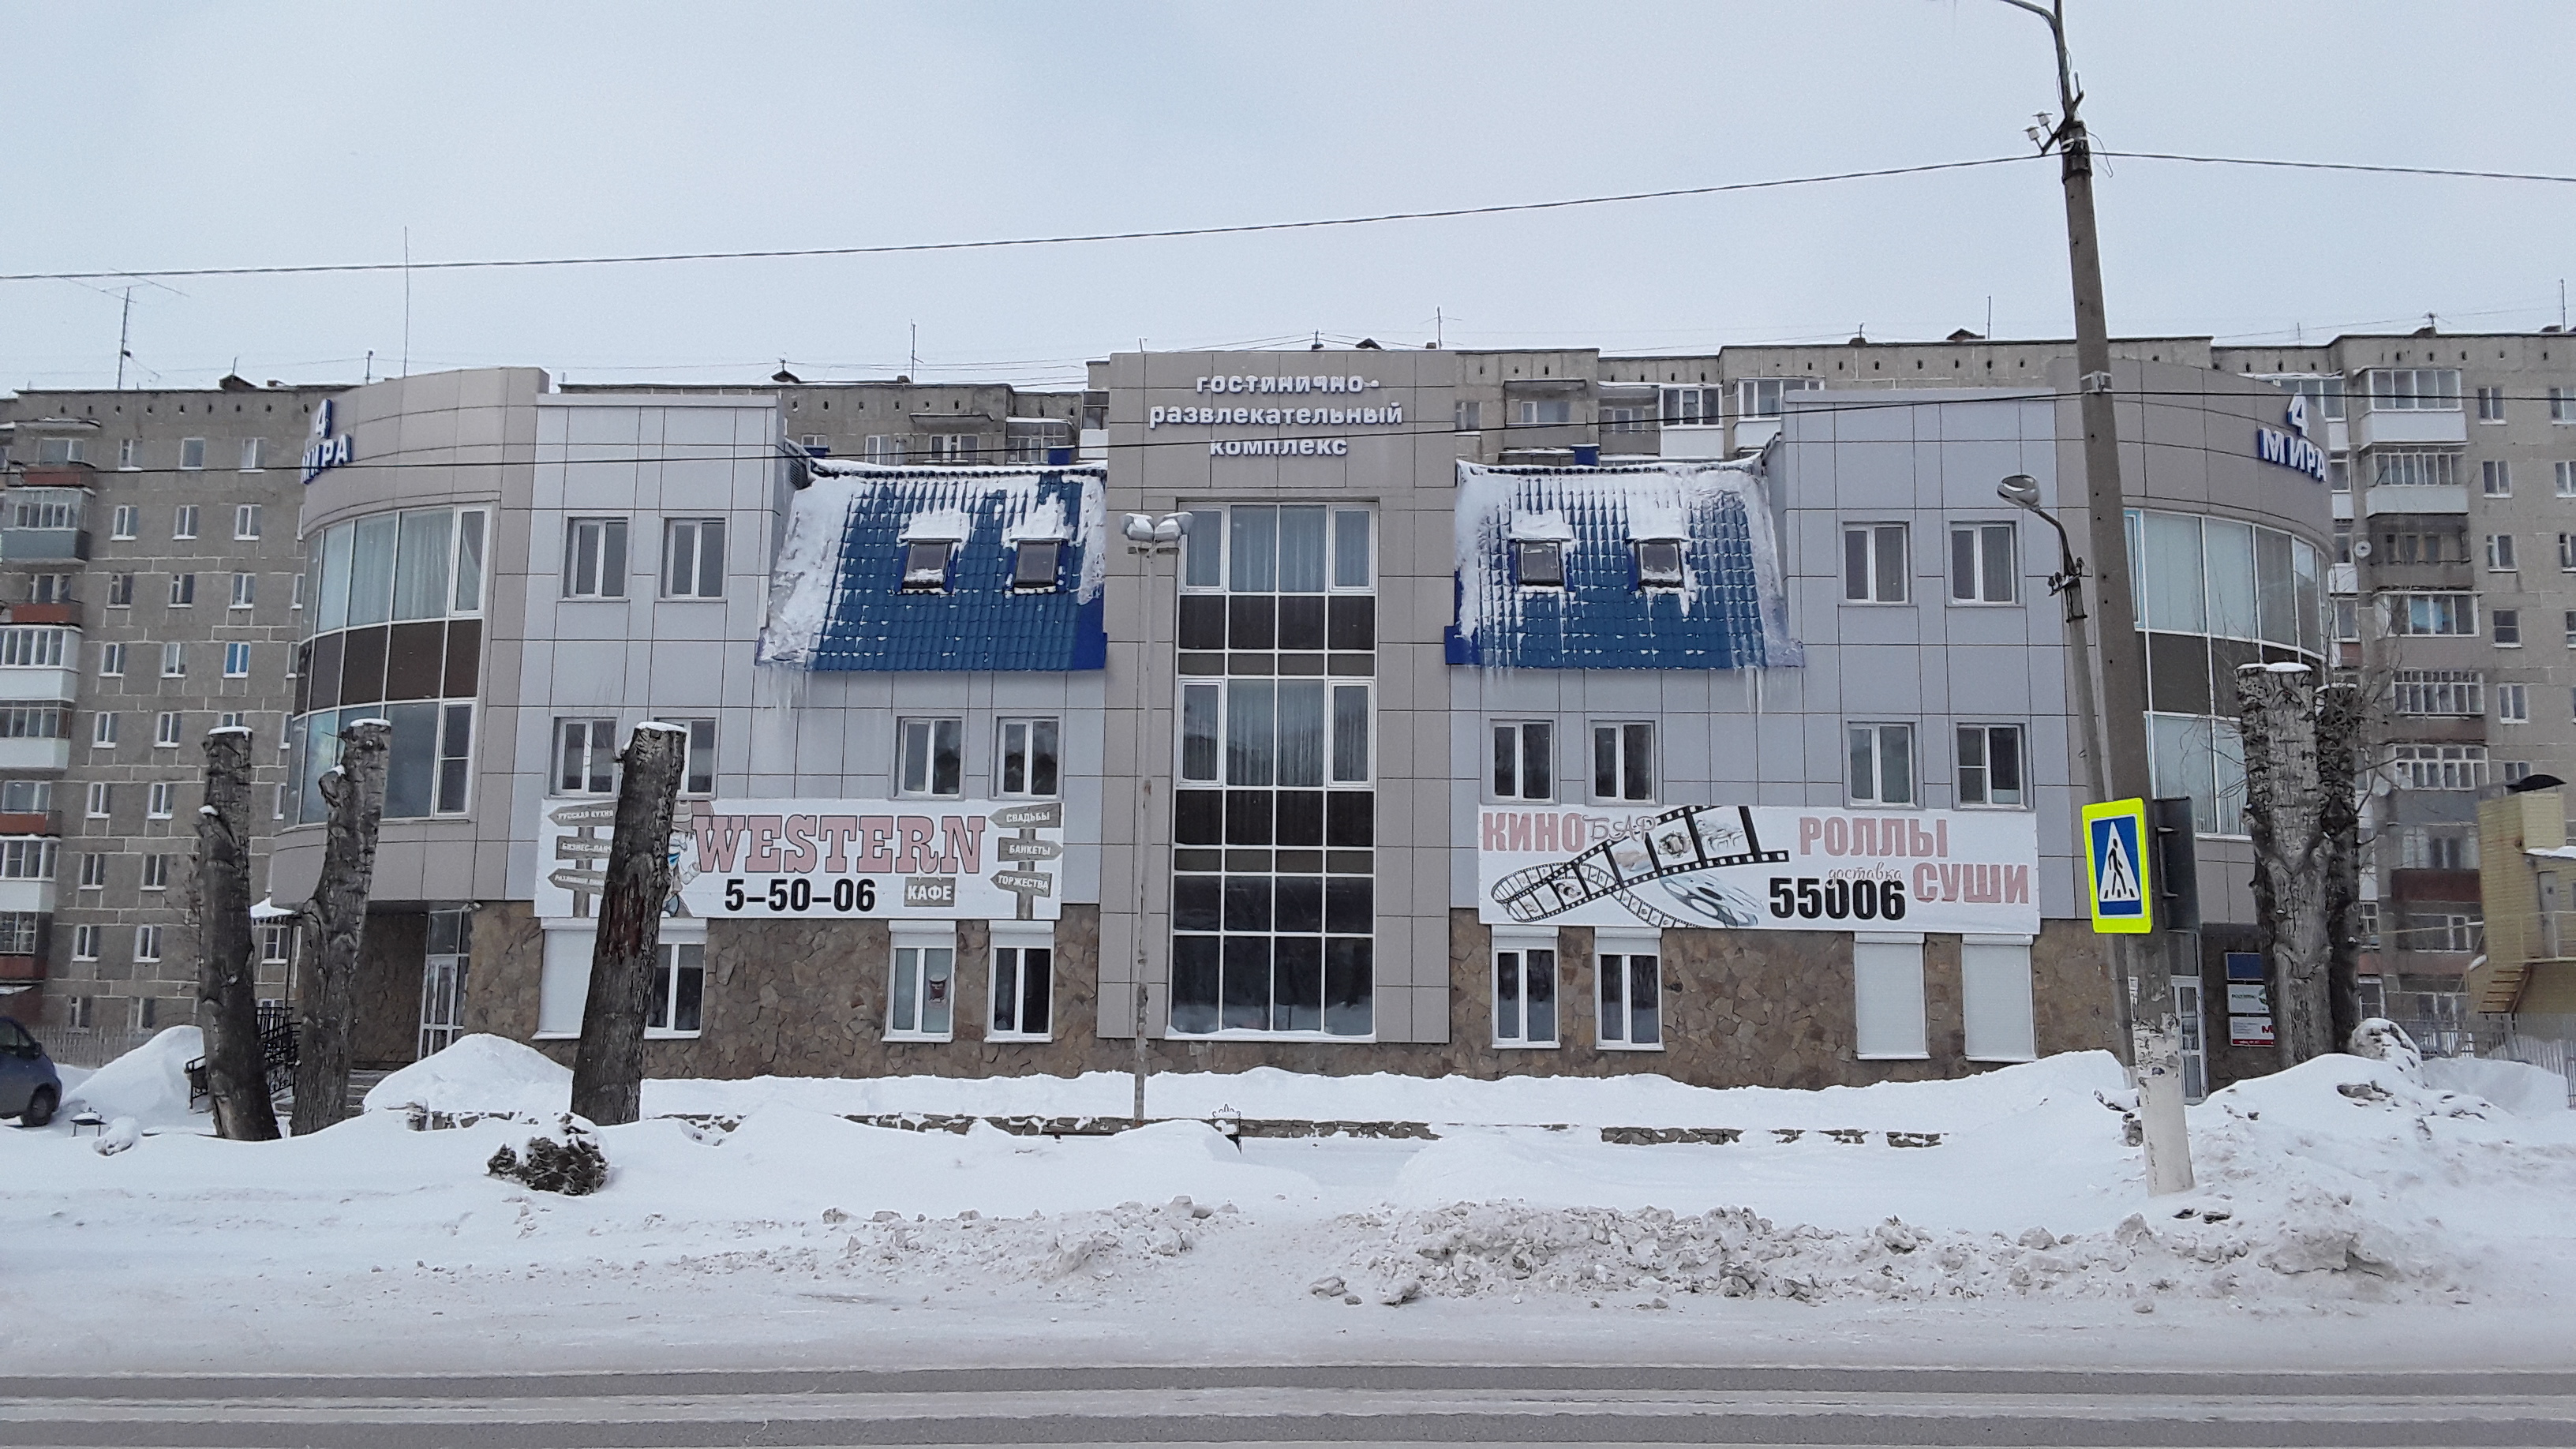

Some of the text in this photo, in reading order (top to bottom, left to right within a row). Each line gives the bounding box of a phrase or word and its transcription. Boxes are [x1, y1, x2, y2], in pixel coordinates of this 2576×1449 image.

[1196, 374, 1380, 394] гостинично-
[315, 399, 333, 439] 4
[1149, 402, 1402, 429] развлекательный
[2286, 392, 2309, 437] 4
[300, 432, 352, 485] МИРА
[1209, 438, 1347, 456] комплекс
[2258, 427, 2327, 482] МИРА
[1006, 811, 1050, 823] СВАДЬБЫ
[1482, 812, 1657, 852] КИНО БАР
[691, 814, 987, 874] WESTERN
[1009, 844, 1051, 856] БАНКЕТЫ
[1799, 816, 1948, 858] РОЛЛЫ
[908, 884, 952, 900] КАФЕ
[998, 874, 1049, 890] ТОРЖЕСТВА
[1828, 861, 1902, 887] доставка
[1913, 862, 2029, 904] СУШИ
[724, 878, 876, 912] 5-50-06
[1769, 877, 1906, 920] 55006
